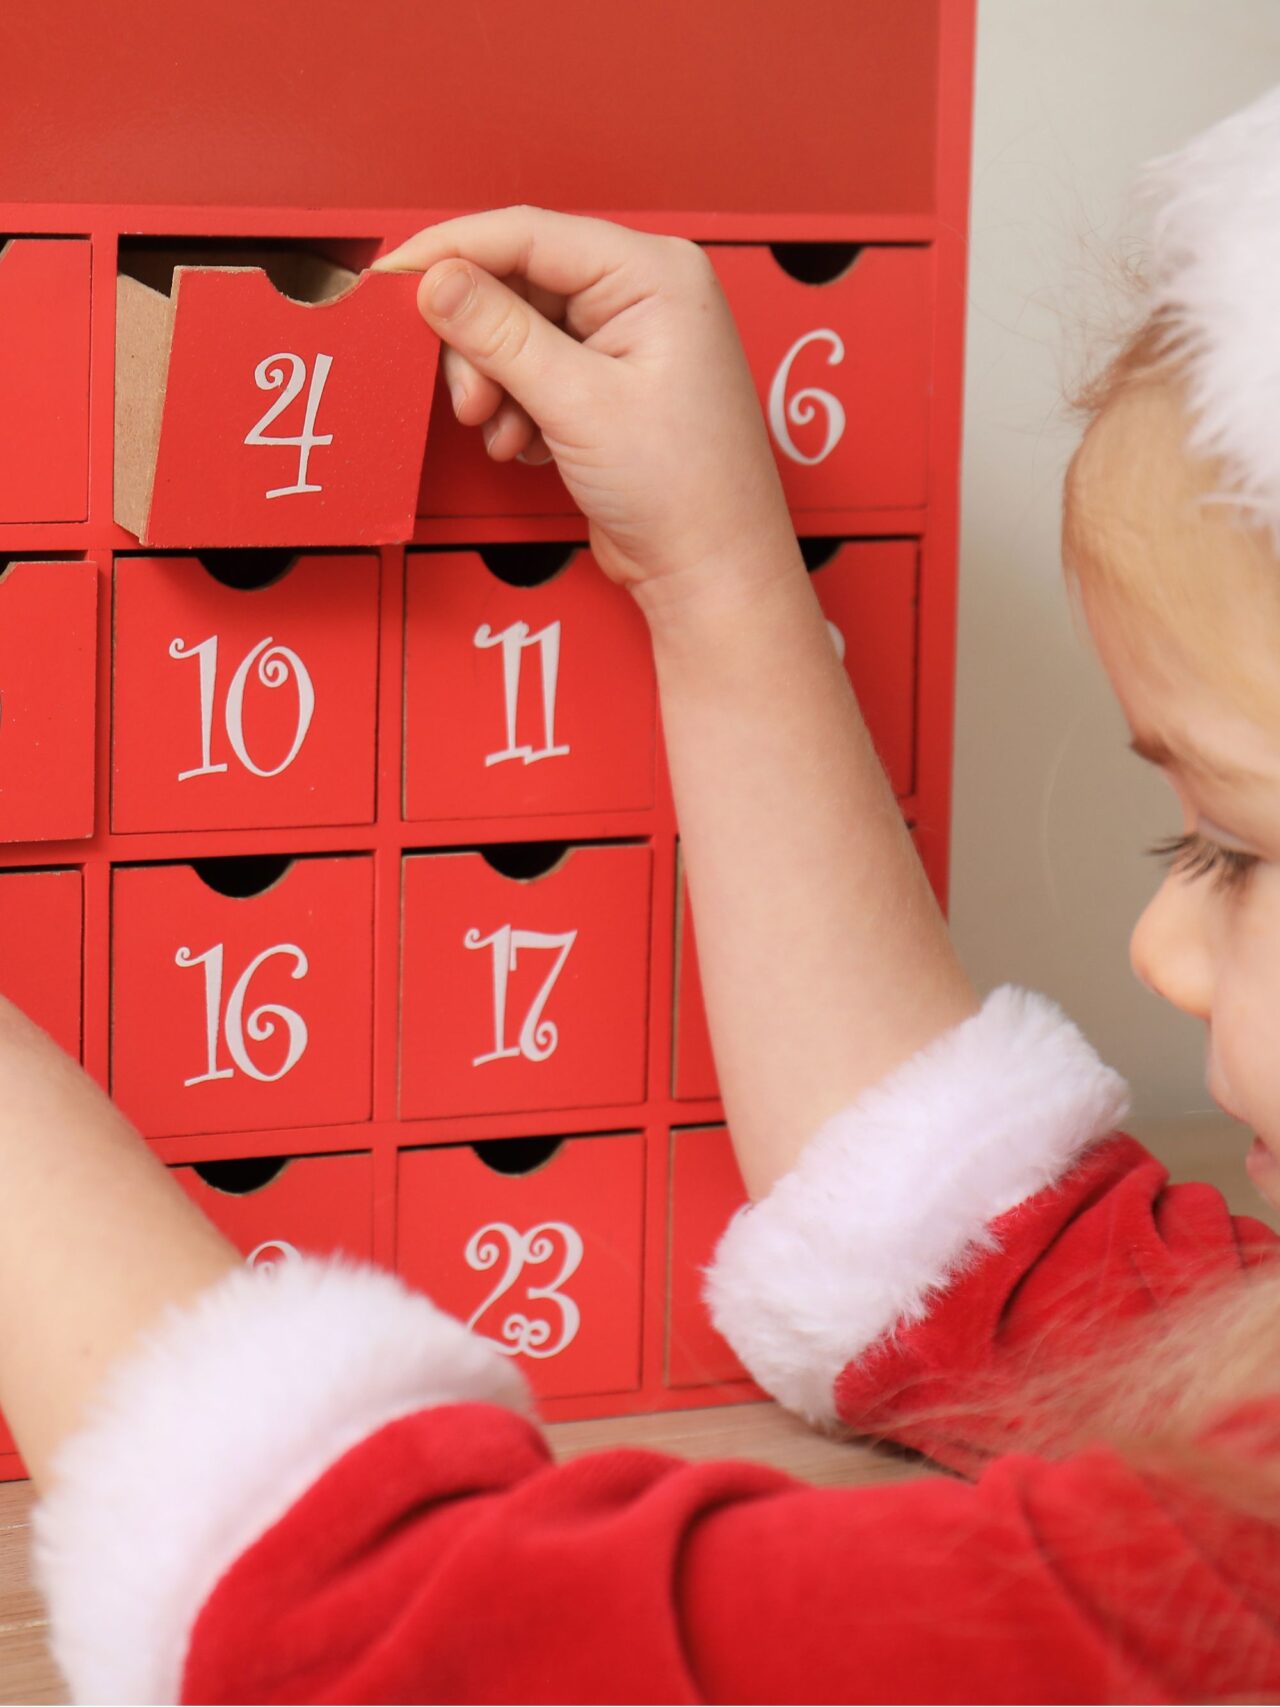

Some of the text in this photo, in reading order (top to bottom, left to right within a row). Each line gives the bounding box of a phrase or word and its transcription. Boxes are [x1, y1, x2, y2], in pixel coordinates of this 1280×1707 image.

[244, 353, 334, 499] 4
[768, 329, 845, 466] 6
[168, 636, 315, 781] 10
[473, 621, 570, 767] 11
[174, 943, 309, 1087] 16
[463, 924, 577, 1067] 17
